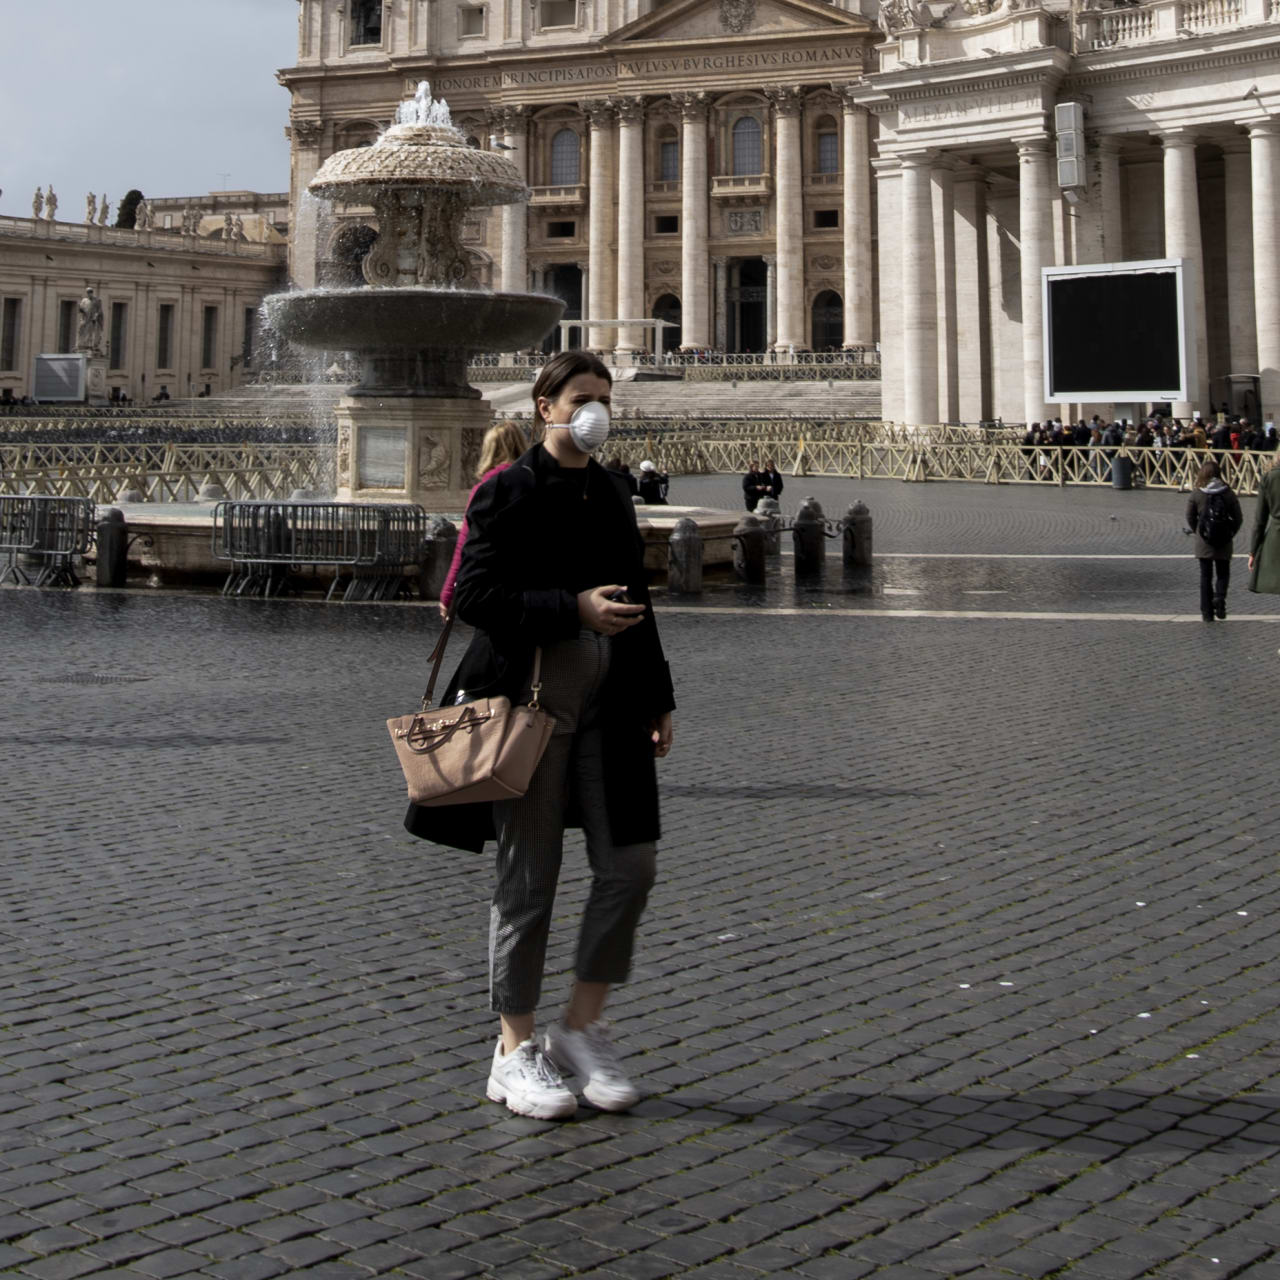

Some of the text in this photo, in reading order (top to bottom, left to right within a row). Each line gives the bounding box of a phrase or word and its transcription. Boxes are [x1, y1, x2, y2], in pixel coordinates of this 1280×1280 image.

[433, 75, 502, 91] HONOREM
[504, 69, 574, 85] PRINCIPIS
[683, 52, 778, 70] BVRGHESIVS
[783, 46, 862, 64] ROMANVS
